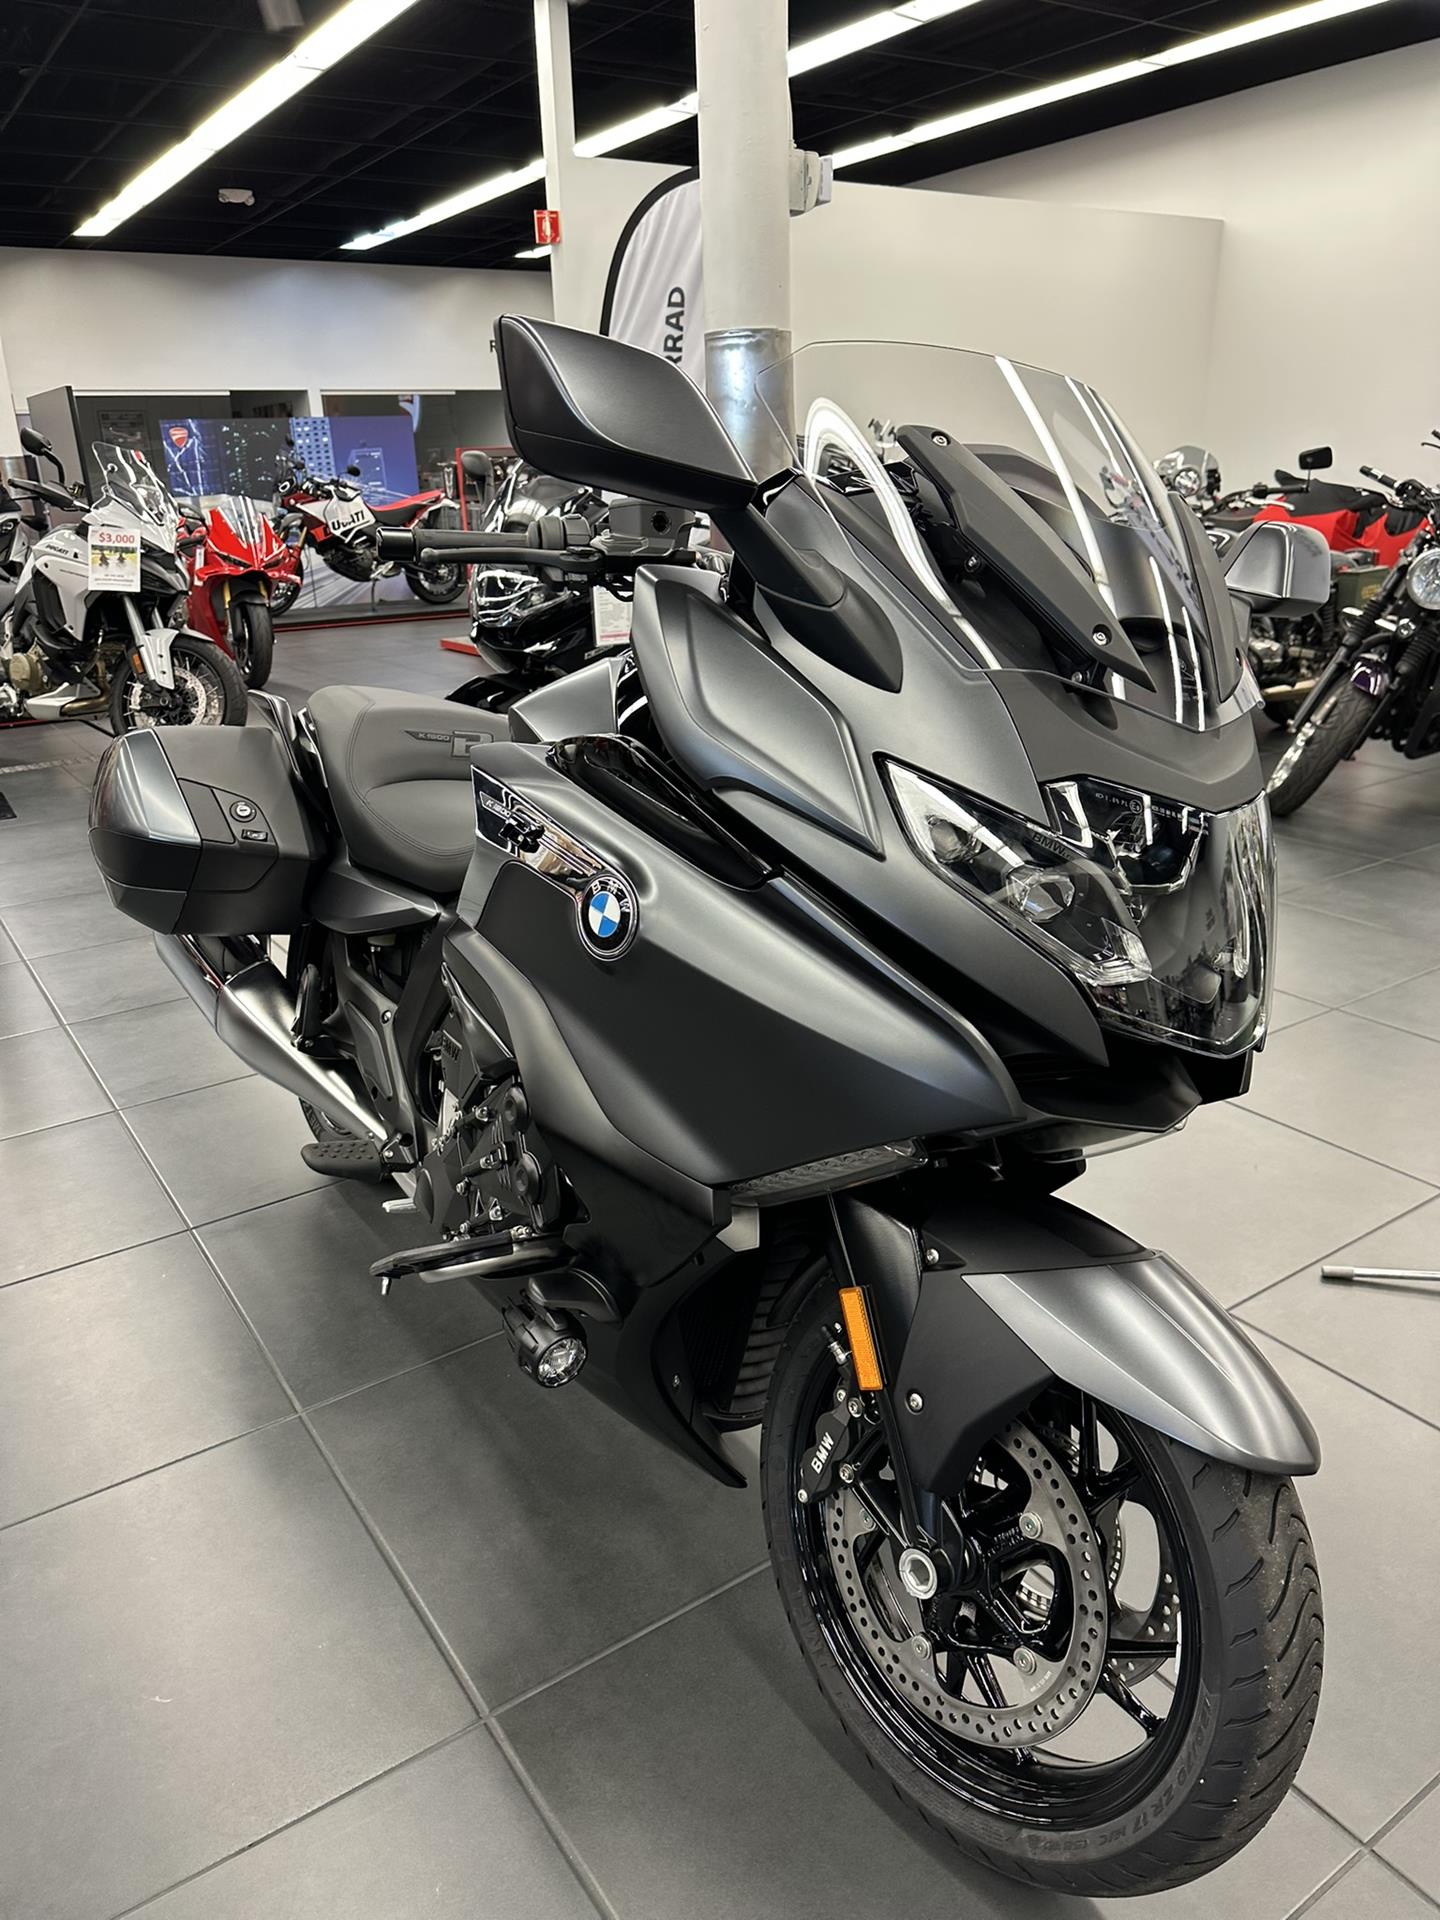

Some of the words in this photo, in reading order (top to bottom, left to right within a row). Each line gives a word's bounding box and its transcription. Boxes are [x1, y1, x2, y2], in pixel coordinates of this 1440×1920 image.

[99, 532, 135, 544] $3,000
[1032, 832, 1065, 856] BMW
[591, 877, 632, 914] BMW
[811, 1431, 834, 1475] BMW
